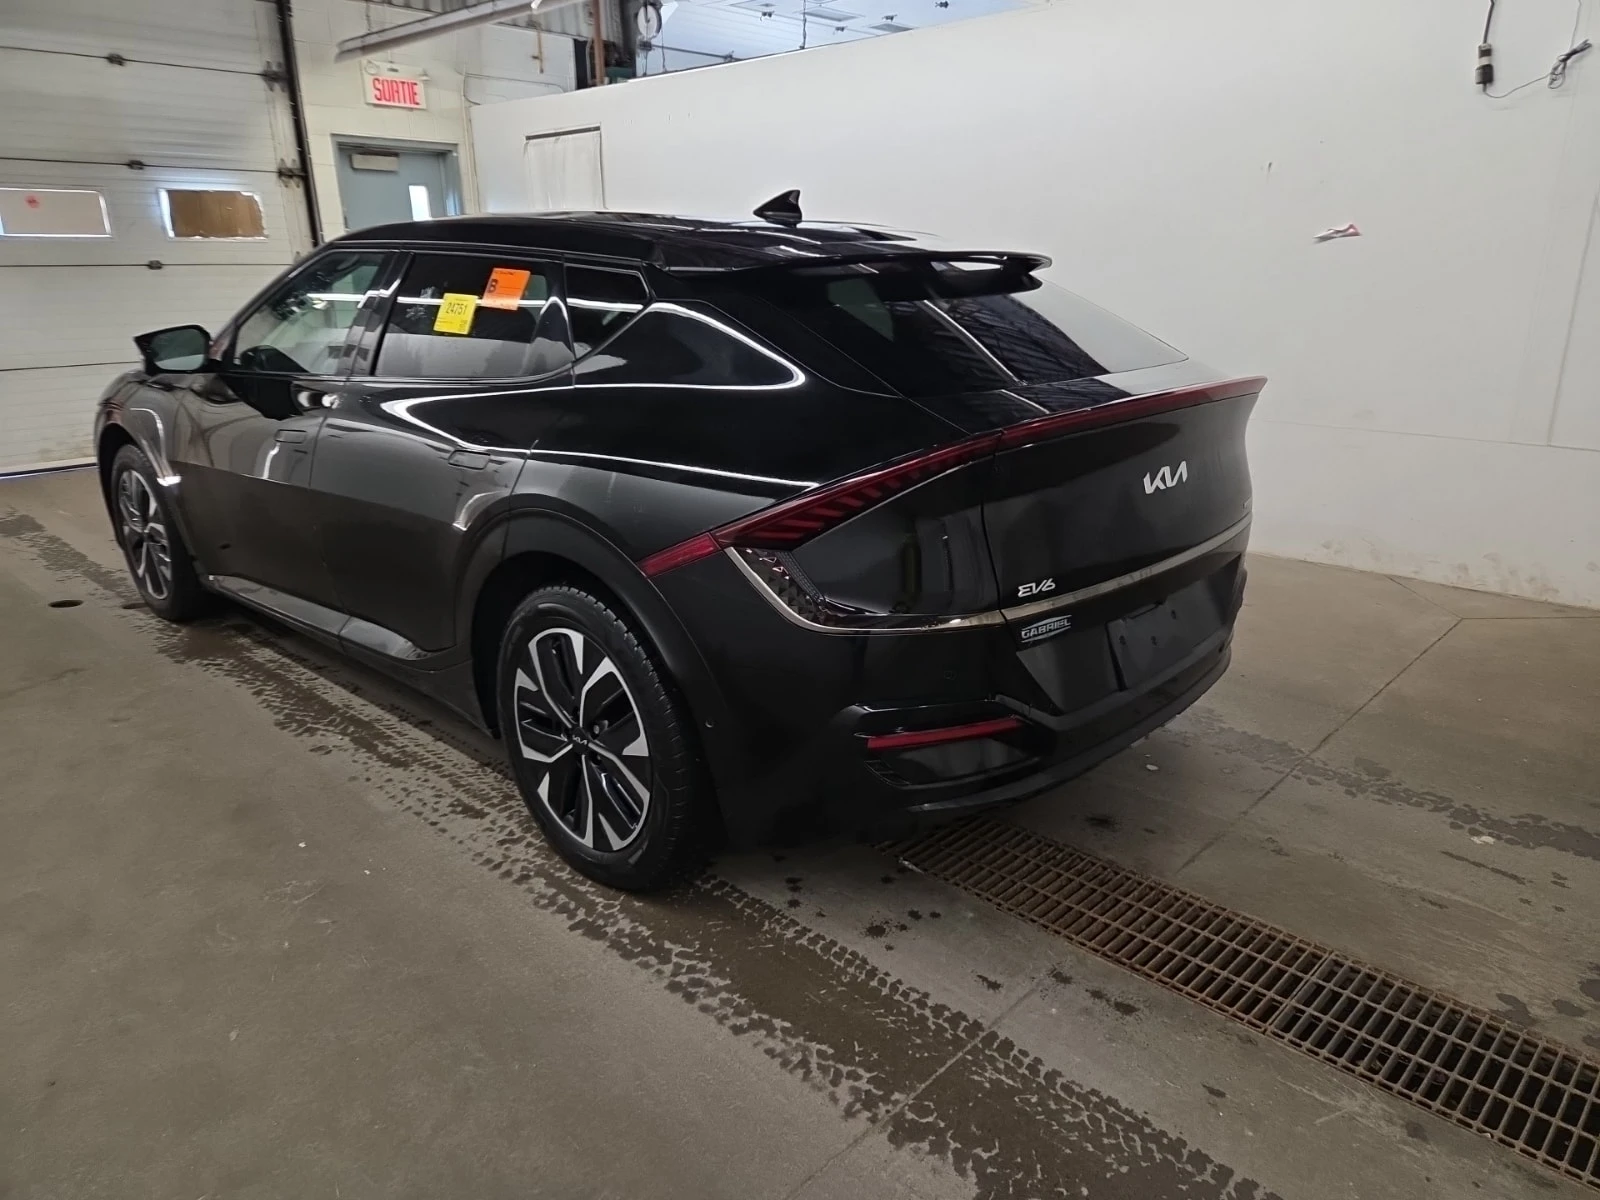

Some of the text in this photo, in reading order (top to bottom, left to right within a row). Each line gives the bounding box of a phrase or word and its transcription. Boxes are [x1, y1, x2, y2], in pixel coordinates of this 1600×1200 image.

[373, 77, 420, 106] SORTIE
[488, 279, 498, 293] B
[445, 302, 468, 316] 24751
[1144, 460, 1188, 495] KIA
[1017, 577, 1056, 598] EV6
[1021, 618, 1072, 639] GABRIEL
